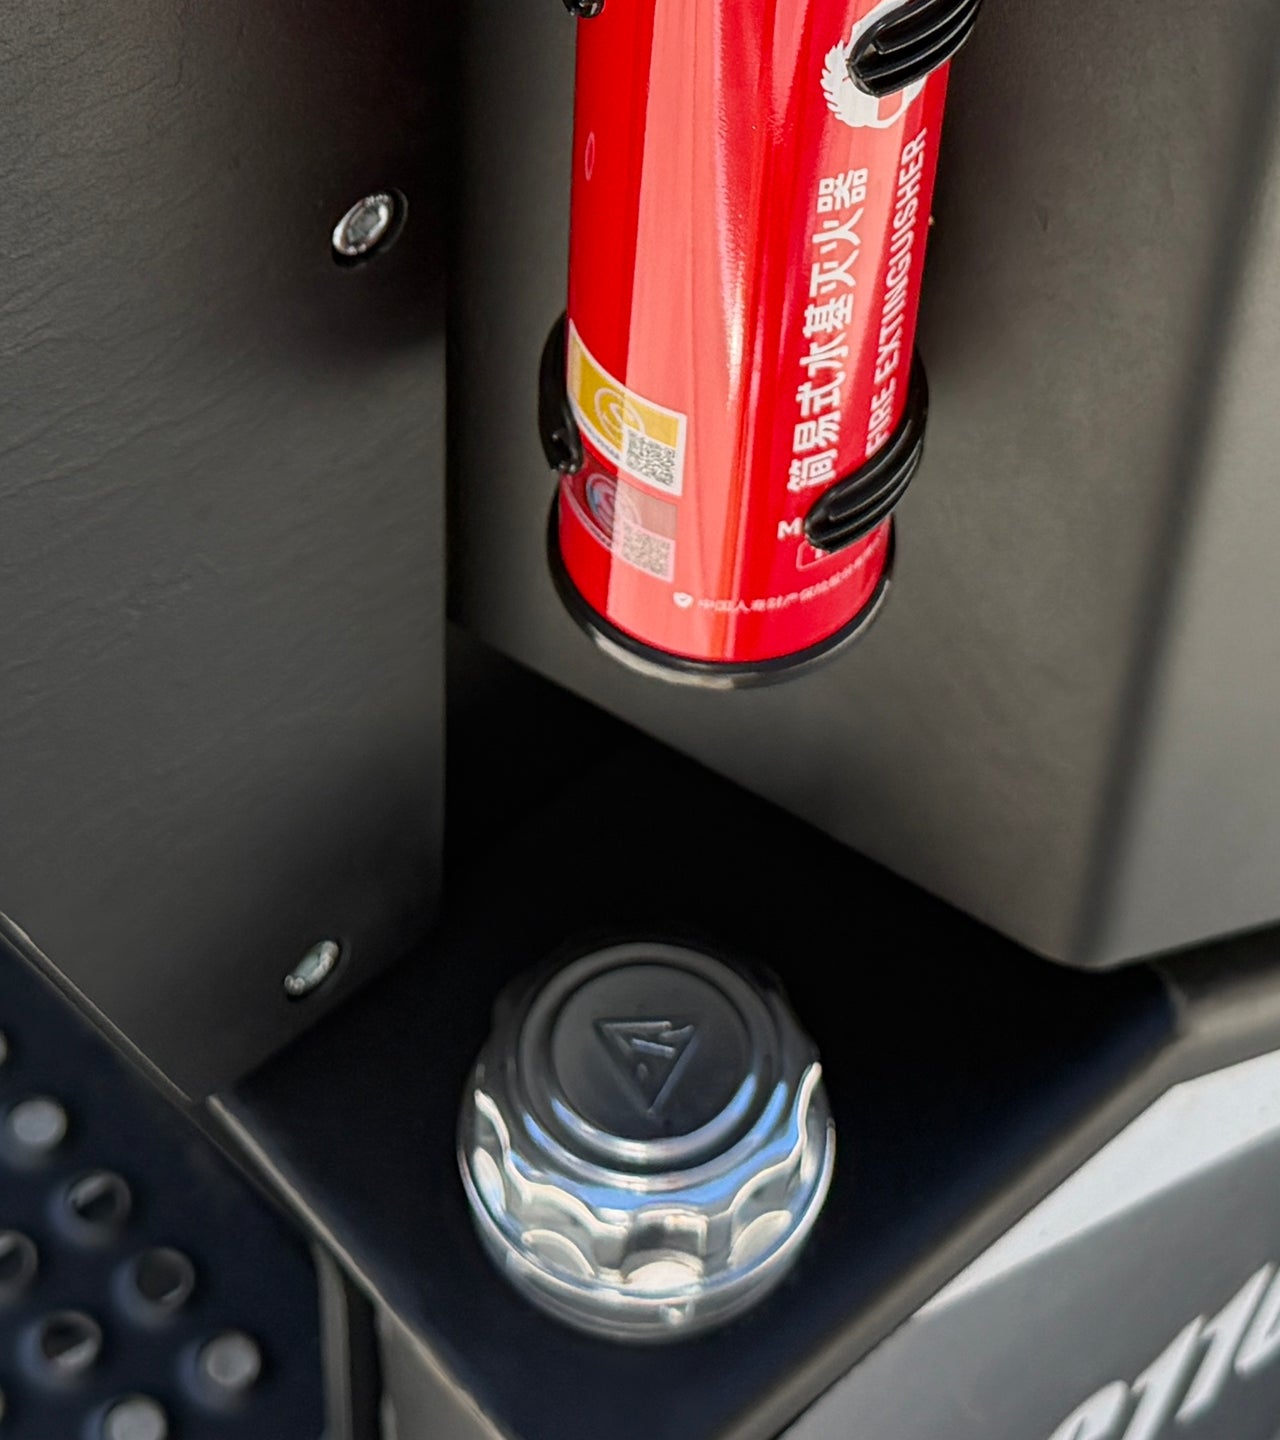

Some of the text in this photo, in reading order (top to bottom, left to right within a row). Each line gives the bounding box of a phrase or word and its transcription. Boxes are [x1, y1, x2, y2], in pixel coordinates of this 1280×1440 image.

[785, 166, 870, 494] 简易式水基灭火器
[864, 127, 928, 460] FIRE EXTINGUISHER
